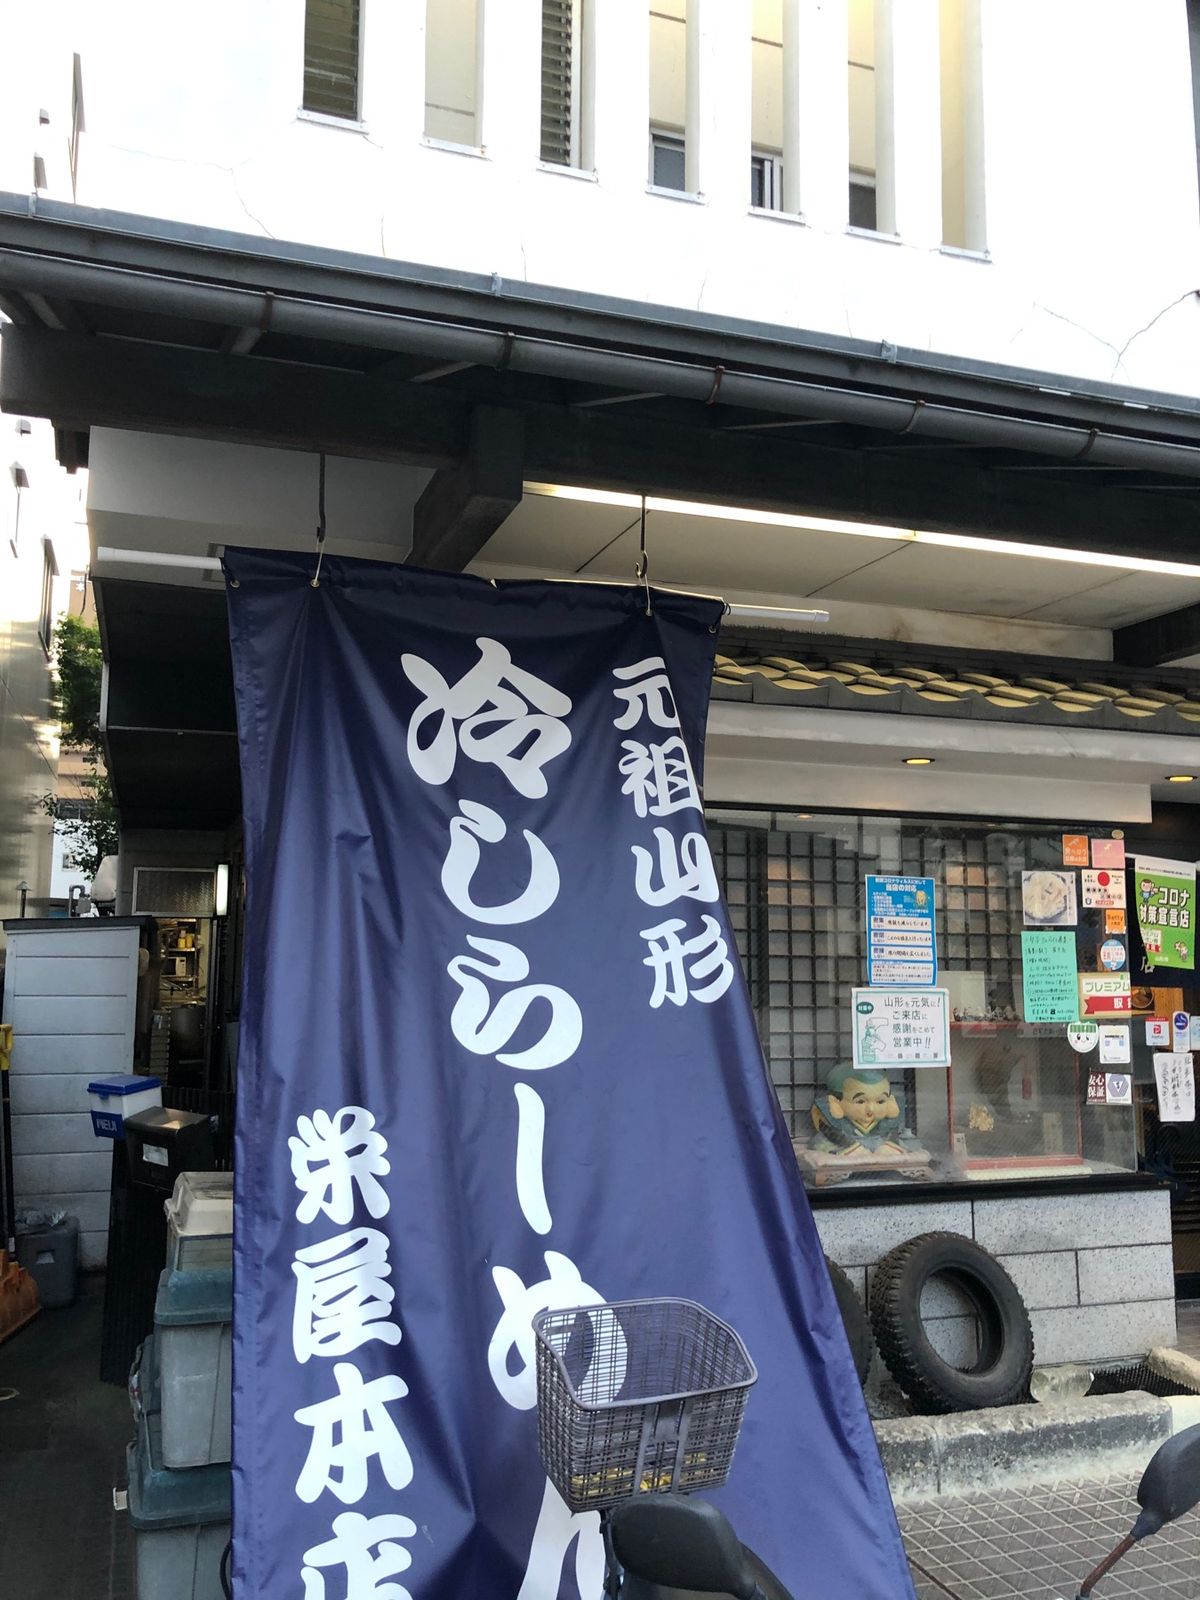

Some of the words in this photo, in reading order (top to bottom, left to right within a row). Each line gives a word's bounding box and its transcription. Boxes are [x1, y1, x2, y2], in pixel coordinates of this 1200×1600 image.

[613, 656, 734, 1008] 元祖山形
[1158, 887, 1190, 907] コロナ
[1140, 904, 1189, 928] 対策宣言店
[884, 996, 941, 1007] 山形を元気に!
[893, 1010, 928, 1020] ご来店に
[893, 1023, 935, 1034] 感謝をこめて
[288, 1105, 417, 1600] 栄屋本店
